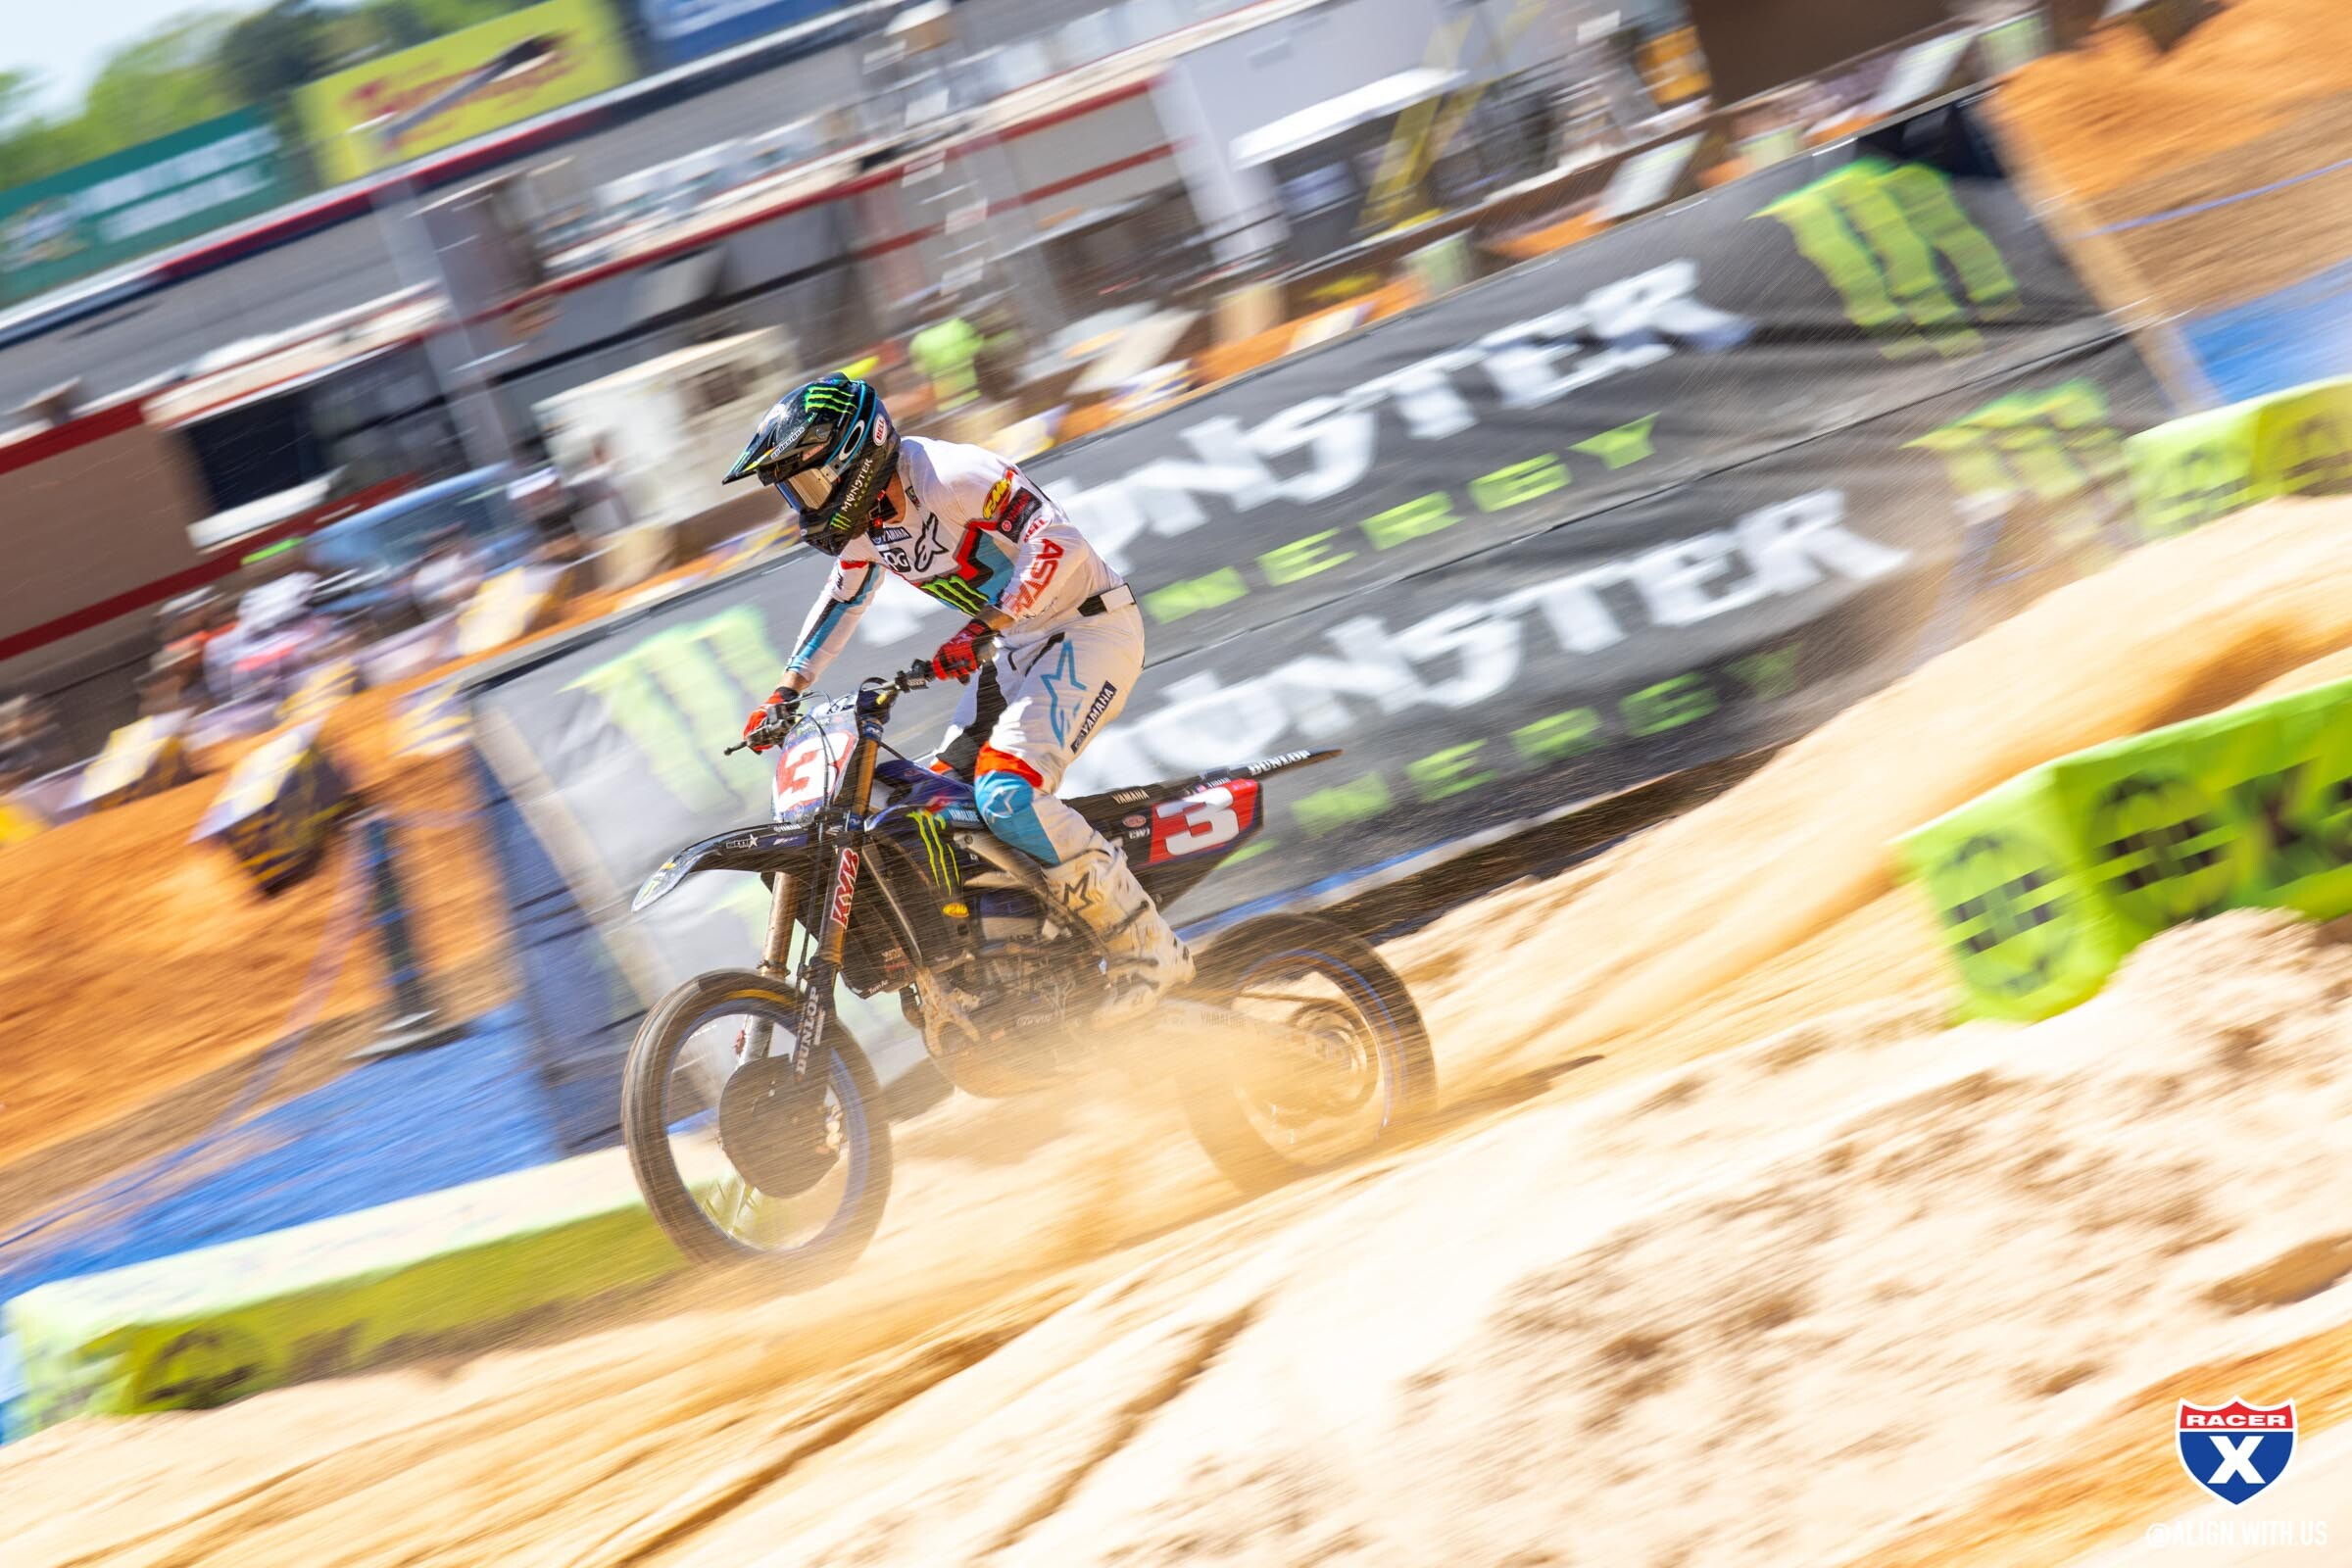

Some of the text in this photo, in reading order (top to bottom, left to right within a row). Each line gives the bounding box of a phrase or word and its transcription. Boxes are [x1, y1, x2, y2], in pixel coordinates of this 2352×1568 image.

[876, 418, 886, 441] BELL
[841, 458, 873, 513] MONSTER
[882, 527, 910, 545] YAMAHA
[1140, 413, 1662, 625] NERGY
[1082, 688, 1114, 734] YAMAHA
[775, 732, 851, 813] 3
[1215, 644, 1801, 870] NERGY
[1248, 750, 1311, 776] DUNLOP
[1111, 788, 1151, 805] YAMAHA
[1155, 787, 1240, 857] 3
[796, 985, 819, 1075] DUNLOP
